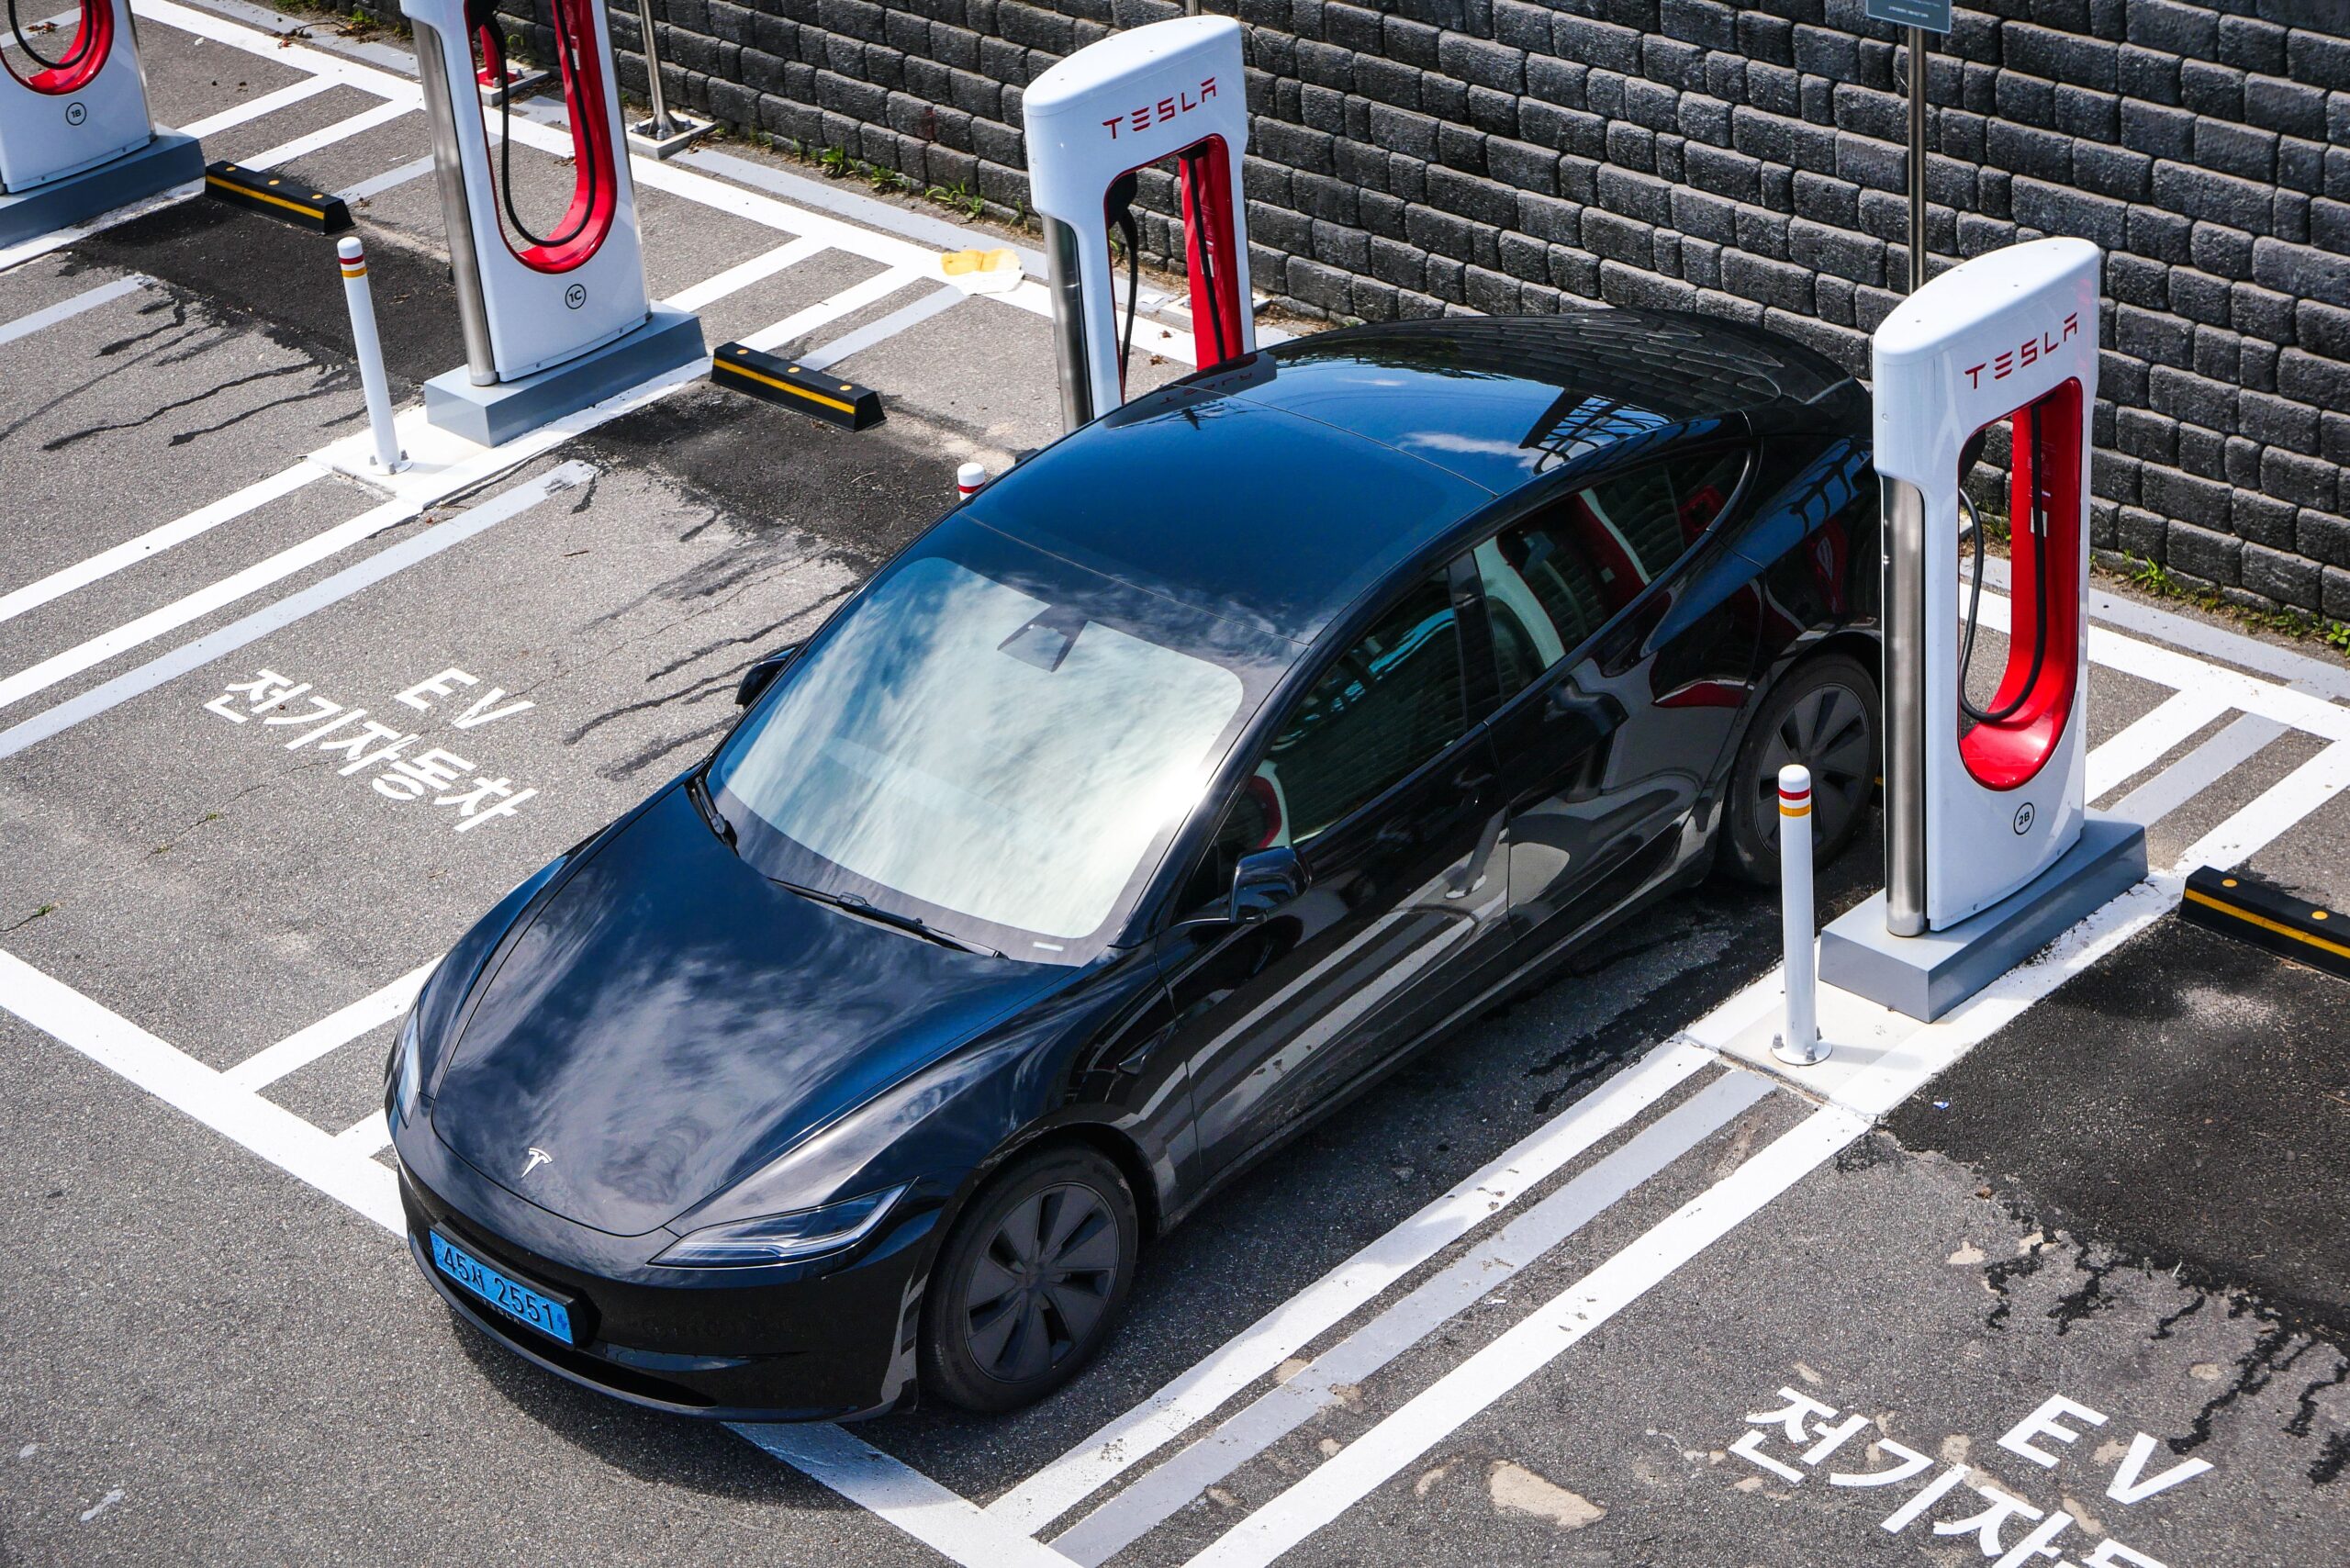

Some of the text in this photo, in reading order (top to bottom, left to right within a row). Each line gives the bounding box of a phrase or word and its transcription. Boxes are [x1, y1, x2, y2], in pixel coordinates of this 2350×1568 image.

[1102, 76, 1217, 140] TESLA
[1964, 312, 2078, 390] TESLA
[394, 666, 537, 730] EV
[202, 667, 540, 834] 전기자동차
[494, 1277, 554, 1330] 2551
[1996, 1393, 2215, 1506] EV
